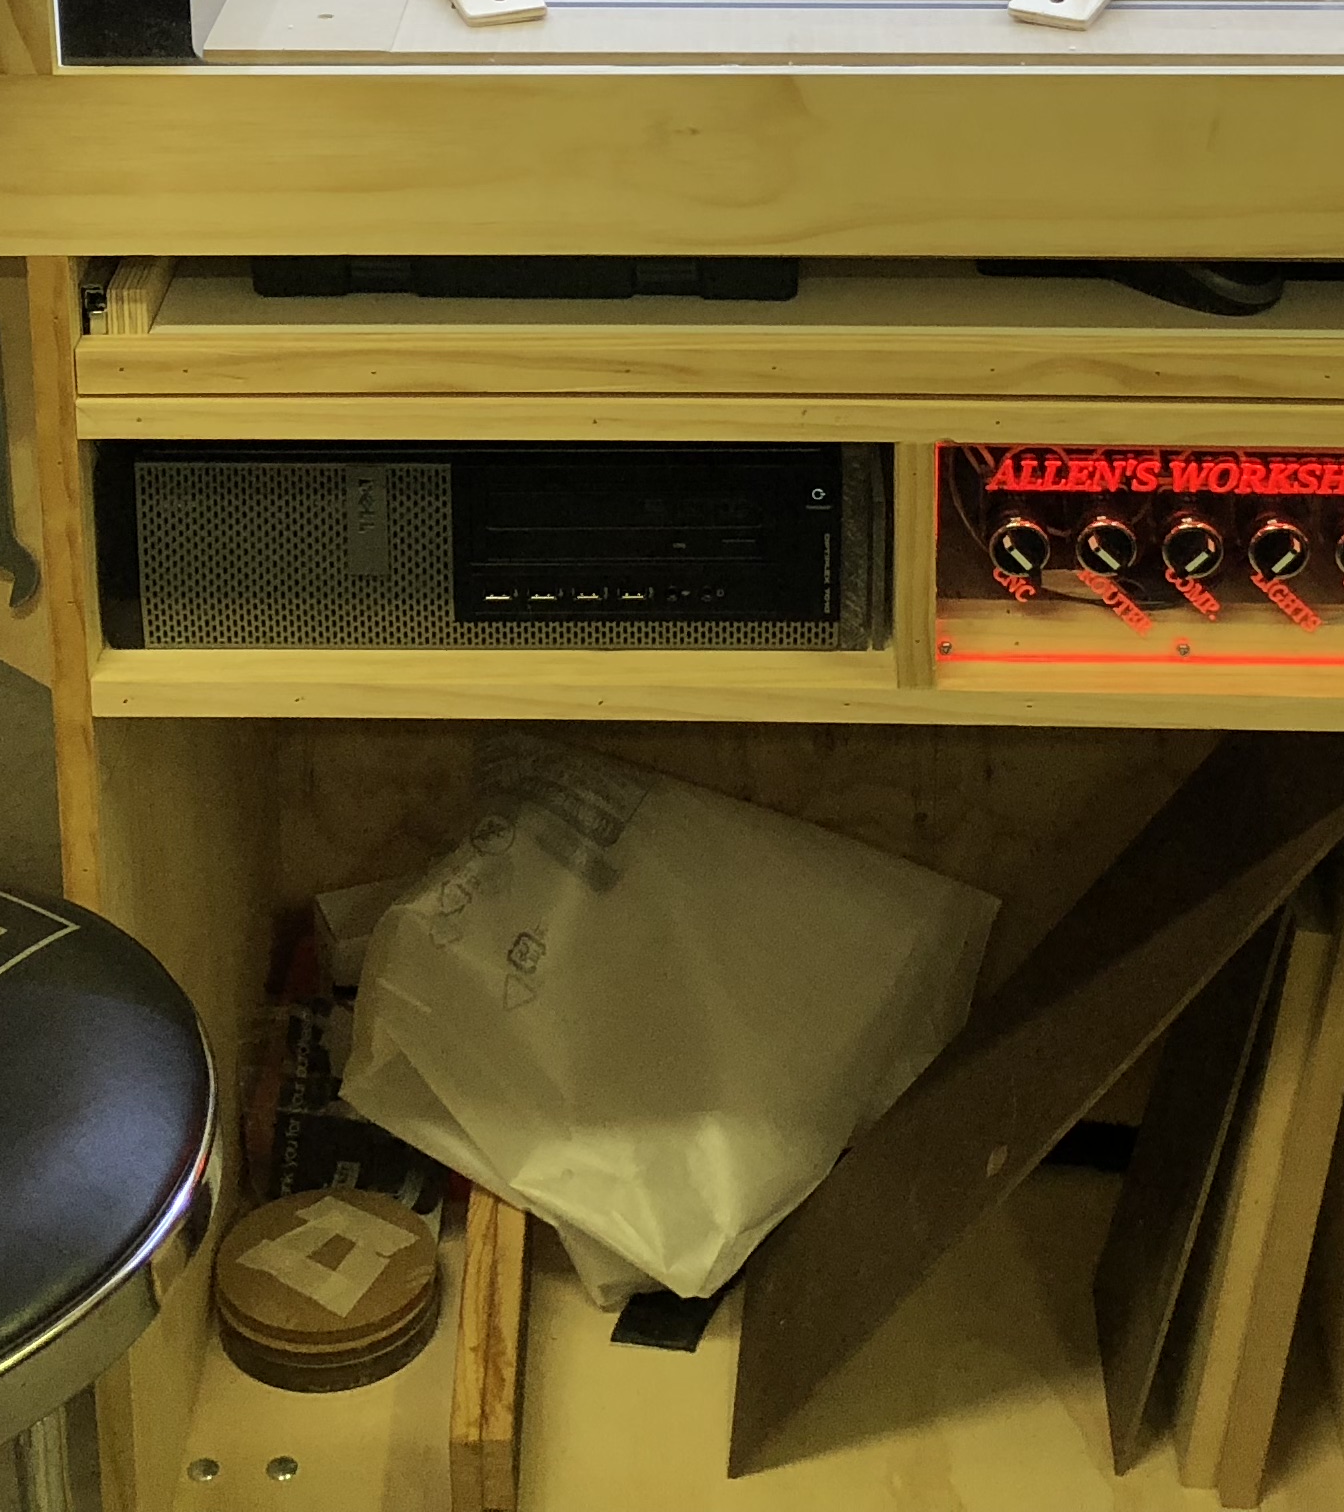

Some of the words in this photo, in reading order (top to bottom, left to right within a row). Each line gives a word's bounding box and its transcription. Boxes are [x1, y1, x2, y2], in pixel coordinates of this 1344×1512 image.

[987, 458, 1161, 493] ALLEN'S
[993, 567, 1037, 602] CNC
[1076, 568, 1154, 636] ROUTER
[1165, 567, 1222, 622] COMP.
[1250, 571, 1323, 633] LIGHTS
